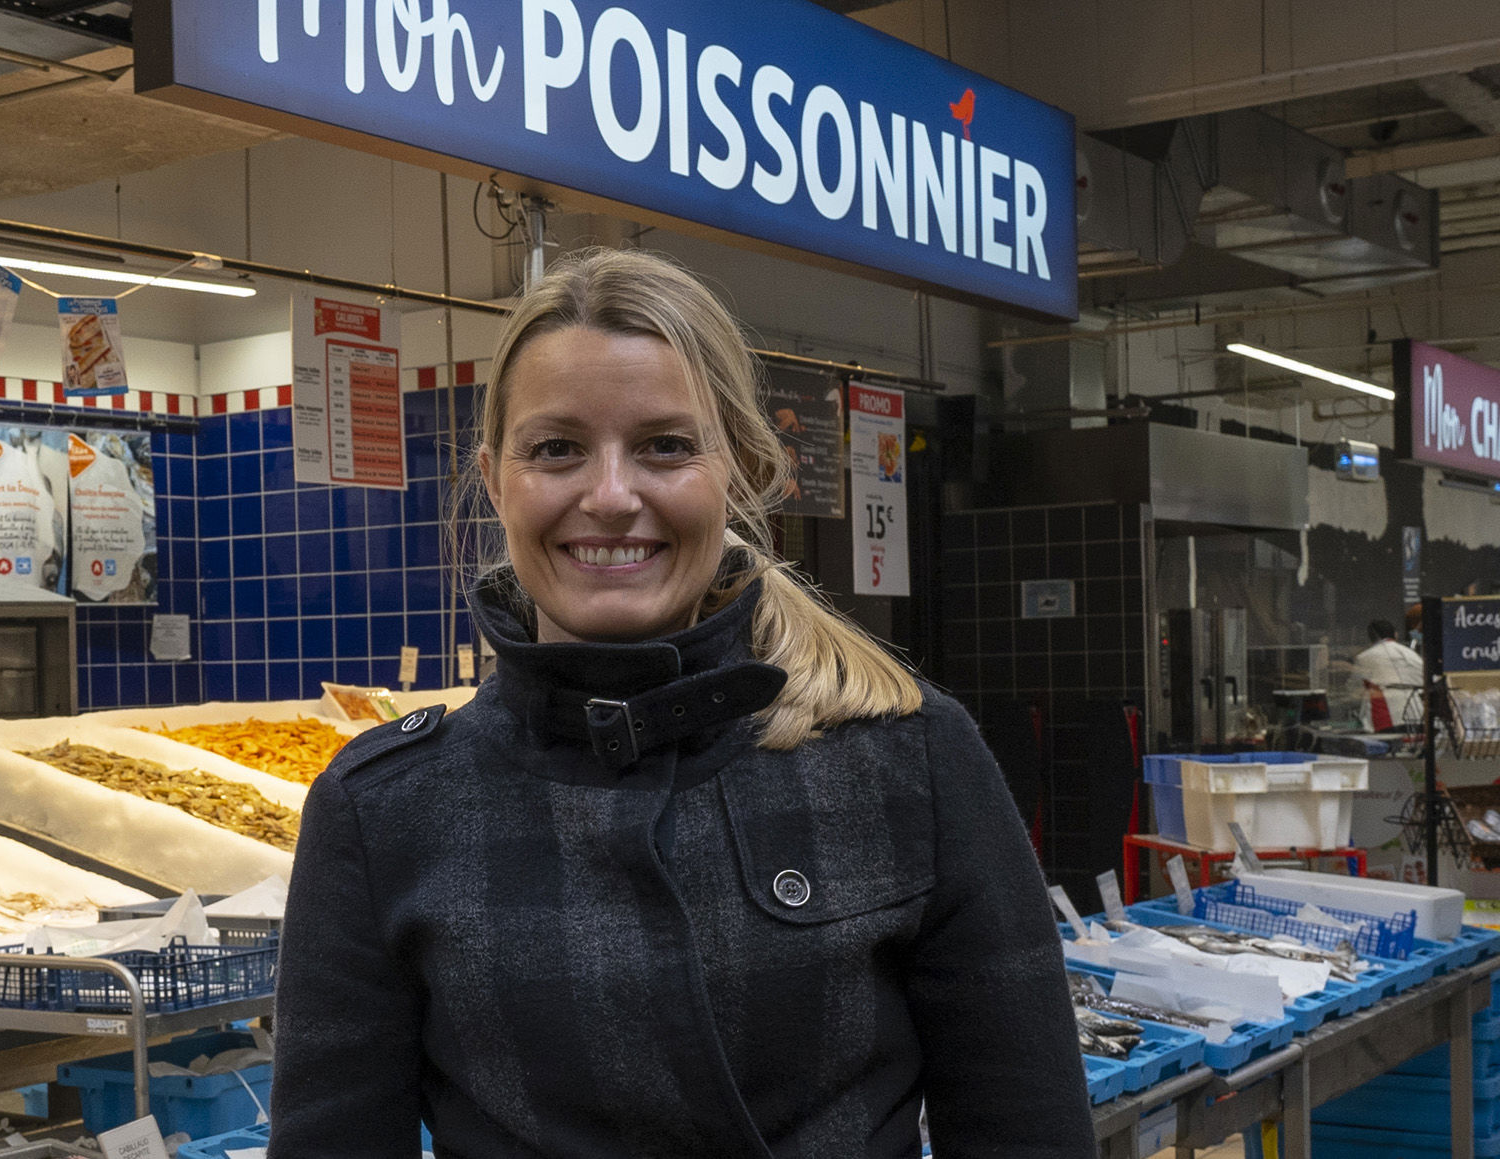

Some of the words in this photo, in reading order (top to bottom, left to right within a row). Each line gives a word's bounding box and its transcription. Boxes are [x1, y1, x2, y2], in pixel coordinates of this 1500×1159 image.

[521, 0, 1051, 281] POISSONNIER
[859, 393, 891, 415] PROMO
[1423, 363, 1466, 452] Mon
[1470, 396, 1500, 462] CH
[866, 503, 894, 540] 15€
